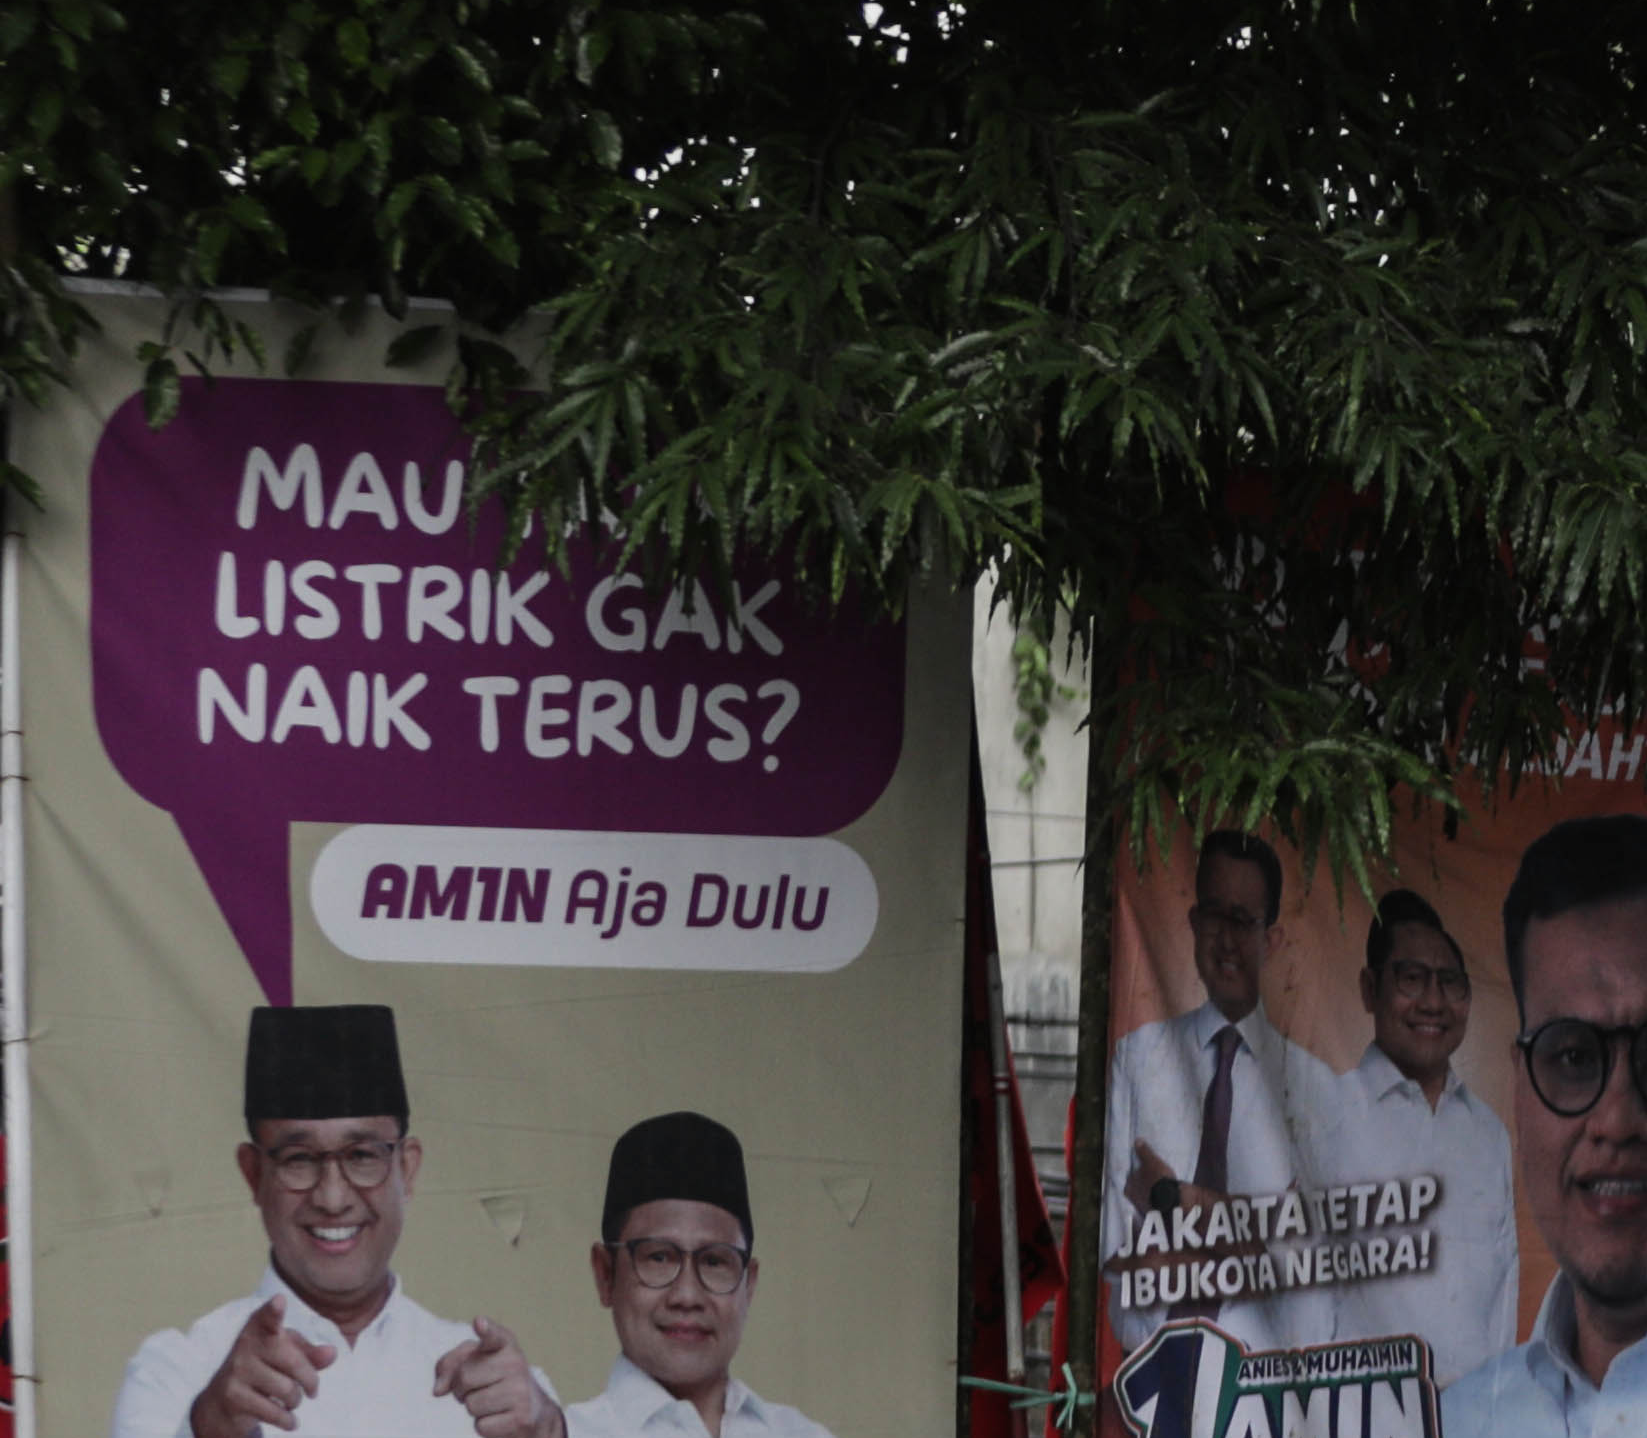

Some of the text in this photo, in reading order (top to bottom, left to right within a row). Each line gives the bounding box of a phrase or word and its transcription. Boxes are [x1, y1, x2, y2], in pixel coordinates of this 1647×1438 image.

[236, 443, 465, 536] MAU
[214, 550, 785, 657] LISTRIK GAK
[197, 662, 802, 773] NAIK TERUS?
[564, 869, 667, 941] Aja
[685, 873, 831, 933] Dulu
[1117, 1175, 1437, 1258] JAKARTA TETAP
[1120, 1229, 1431, 1309] IBUKOTA NEGARA!
[1237, 1358, 1292, 1385] ANIES
[1308, 1341, 1418, 1378] MUHAIMIN
